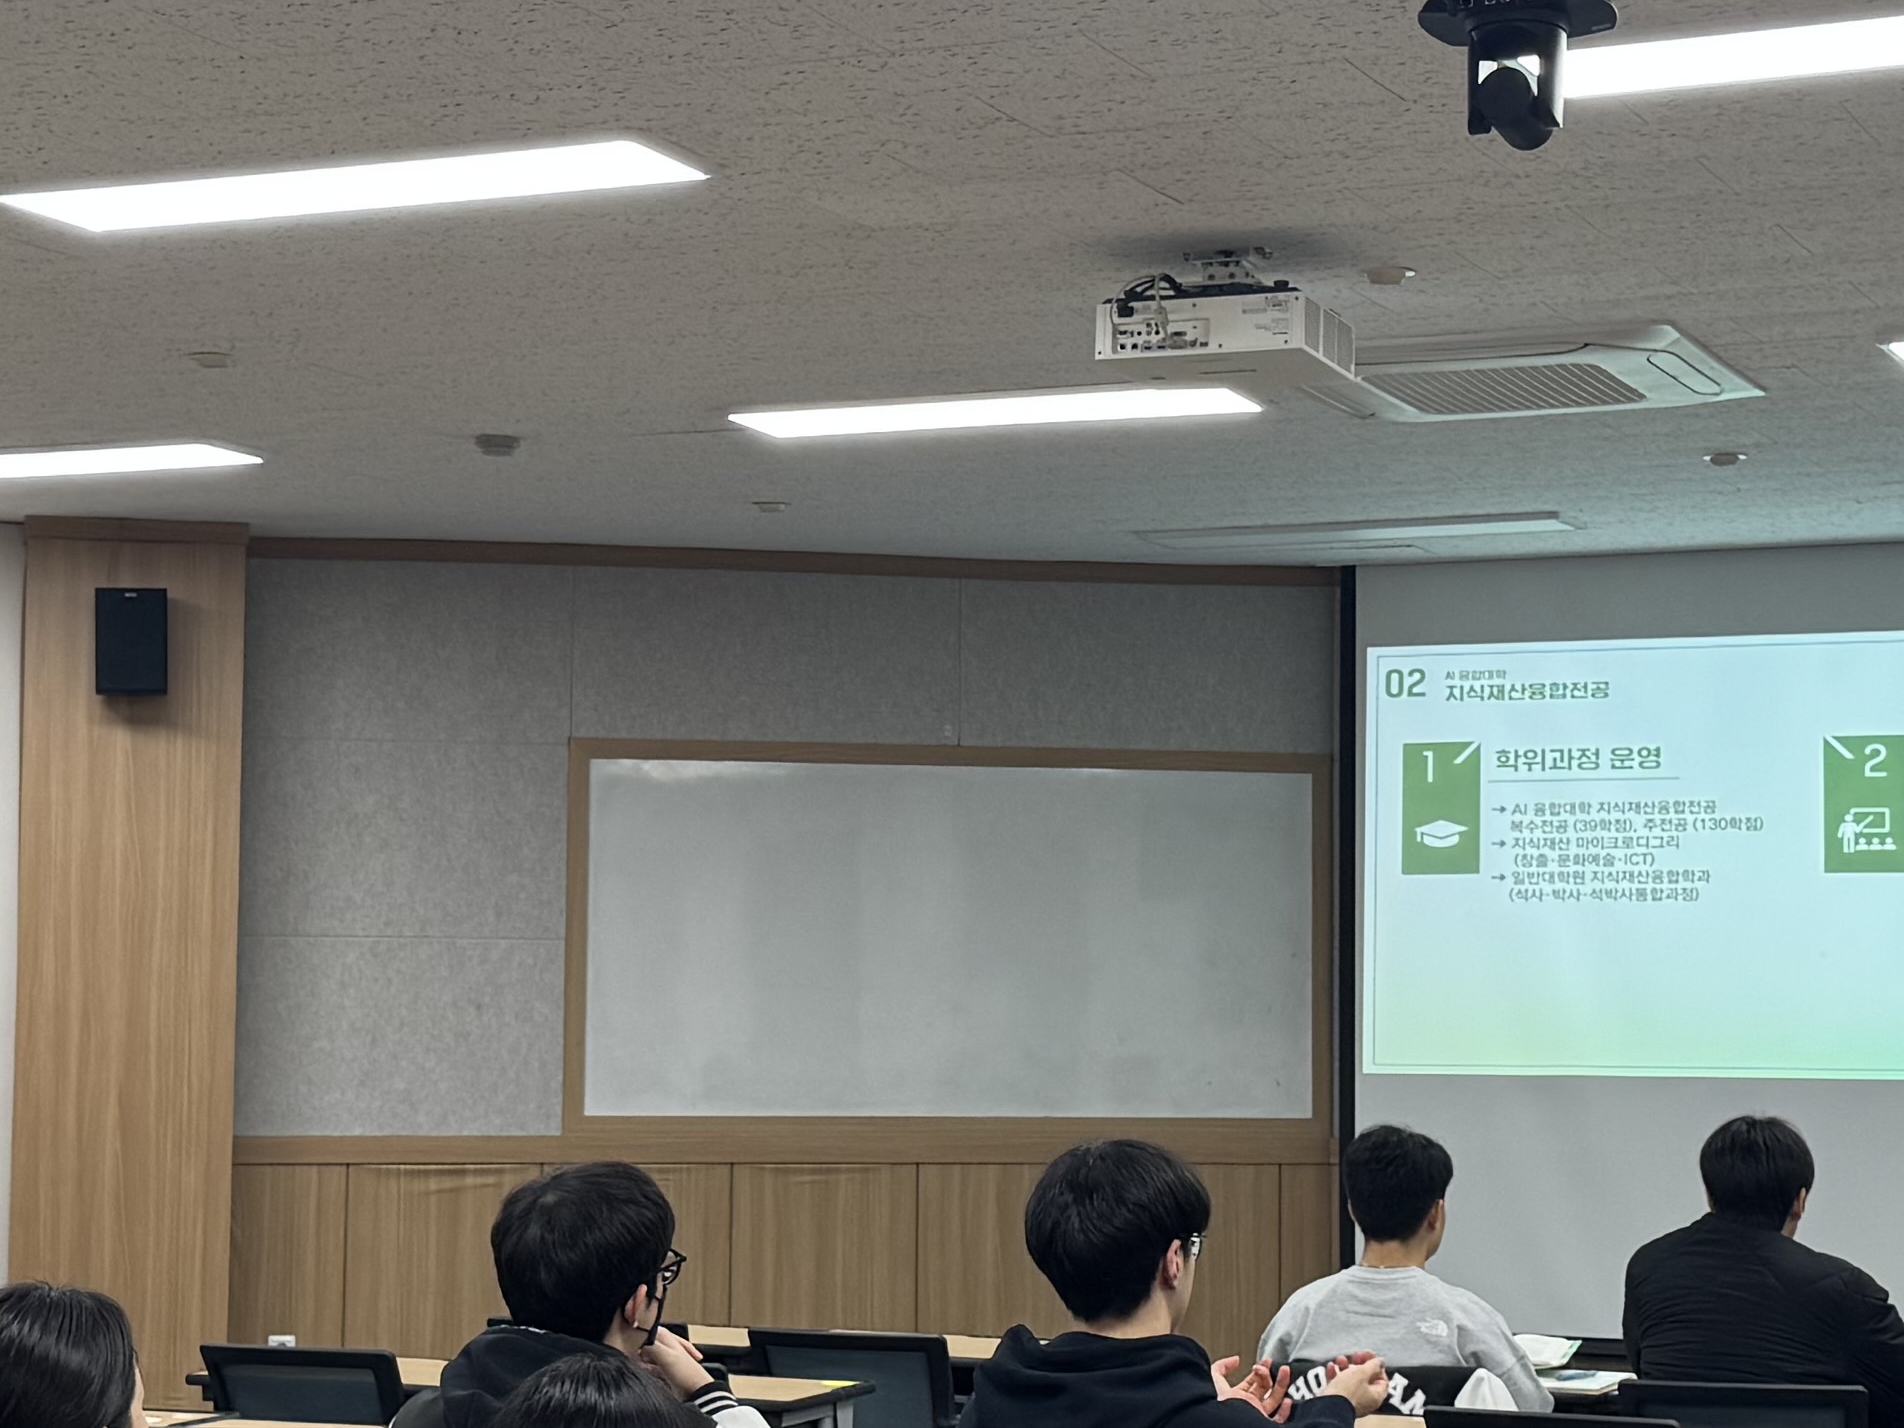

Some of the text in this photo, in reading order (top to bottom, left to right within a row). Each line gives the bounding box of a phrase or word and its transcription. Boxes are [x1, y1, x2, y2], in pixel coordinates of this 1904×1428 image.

[1385, 668, 1427, 698] 02
[1445, 681, 1611, 702] 지식재산융합전공
[1422, 750, 1434, 783] 1
[1495, 746, 1663, 772] 학위과정 운영
[1864, 743, 1888, 778] 2
[1510, 800, 1717, 816] AI 융합대학 지식재산융합전공
[1510, 819, 1569, 834] 복수전공
[1642, 817, 1688, 832] 주전공
[1511, 835, 1680, 851] 지식재산 마이크로디그리
[1511, 869, 1712, 885] 일반대학원 지식재산융합학과
